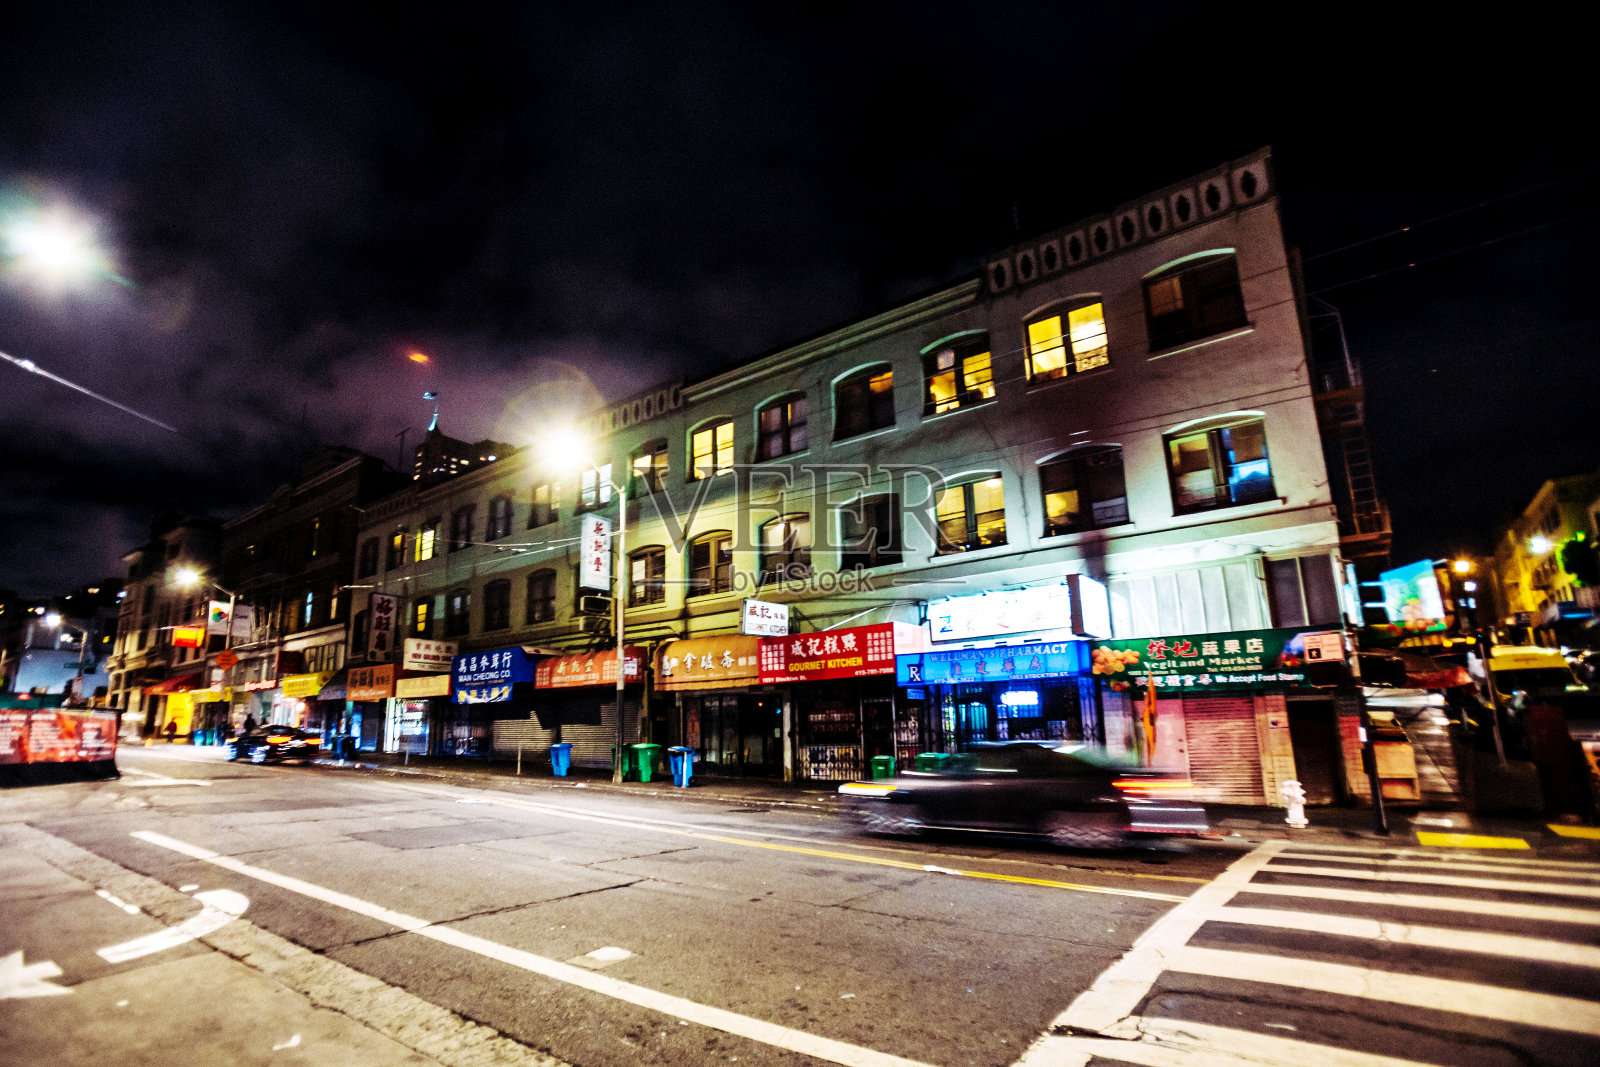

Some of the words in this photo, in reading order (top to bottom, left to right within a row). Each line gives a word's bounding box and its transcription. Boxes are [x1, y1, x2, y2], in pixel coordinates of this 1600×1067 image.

[999, 643, 1069, 659] PHARMACY
[788, 660, 825, 672] GOURMET
[827, 657, 863, 669] KITCHEN
[1209, 655, 1261, 666] Market
[473, 671, 499, 681] CHEONG
[1229, 674, 1256, 683] Accept
[1257, 673, 1277, 681] Food
